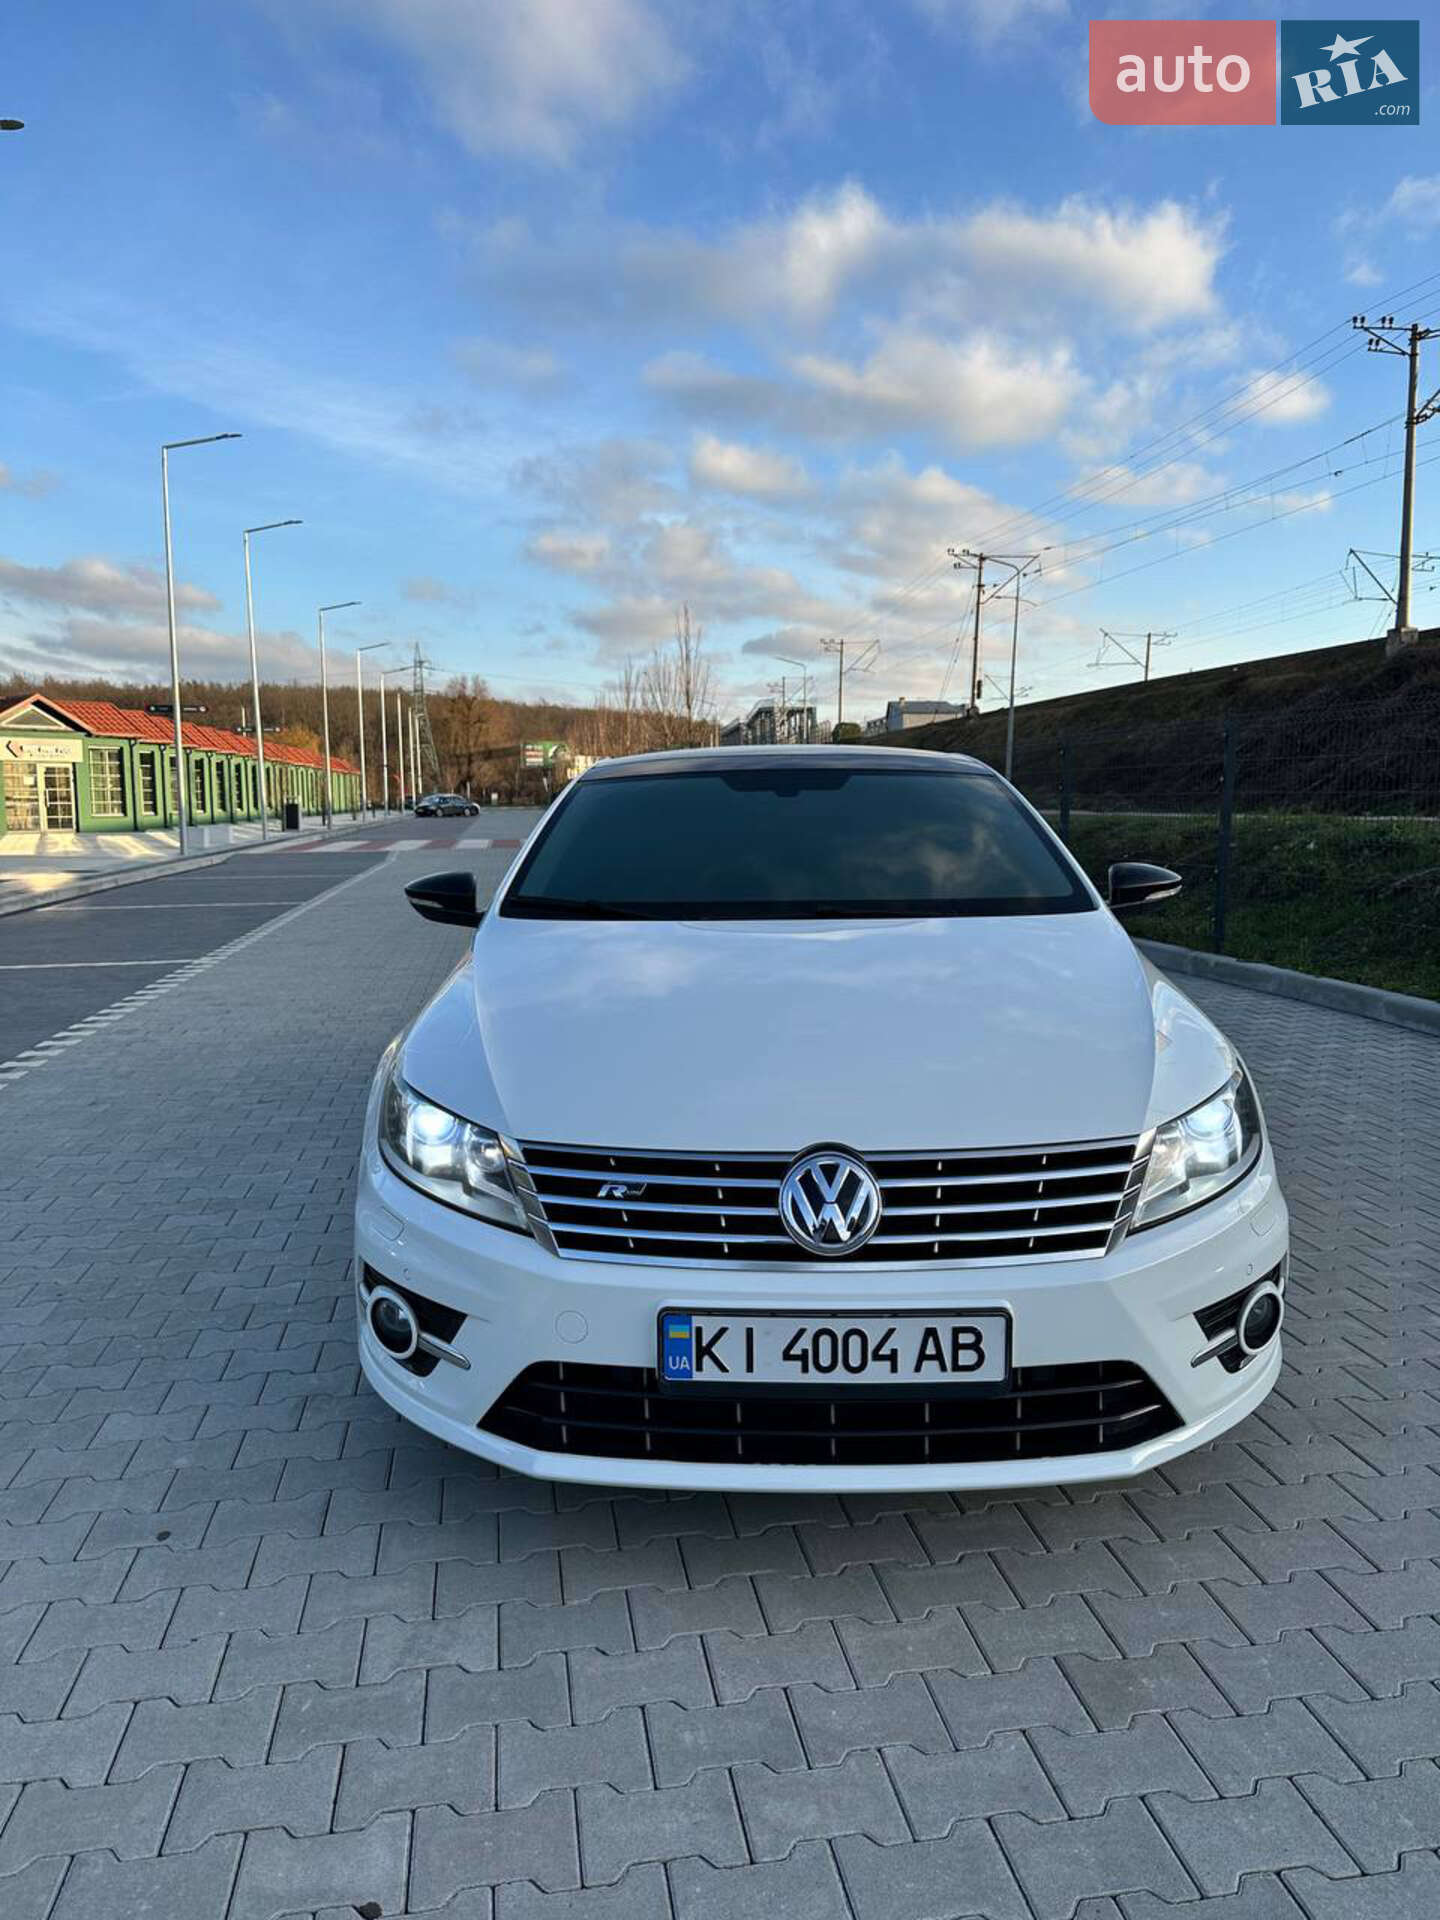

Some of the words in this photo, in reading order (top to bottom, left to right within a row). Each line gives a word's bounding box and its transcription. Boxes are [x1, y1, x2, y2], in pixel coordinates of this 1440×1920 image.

[668, 1356, 690, 1371] UA
[782, 1326, 898, 1374] 4004
[914, 1326, 986, 1373] AB
